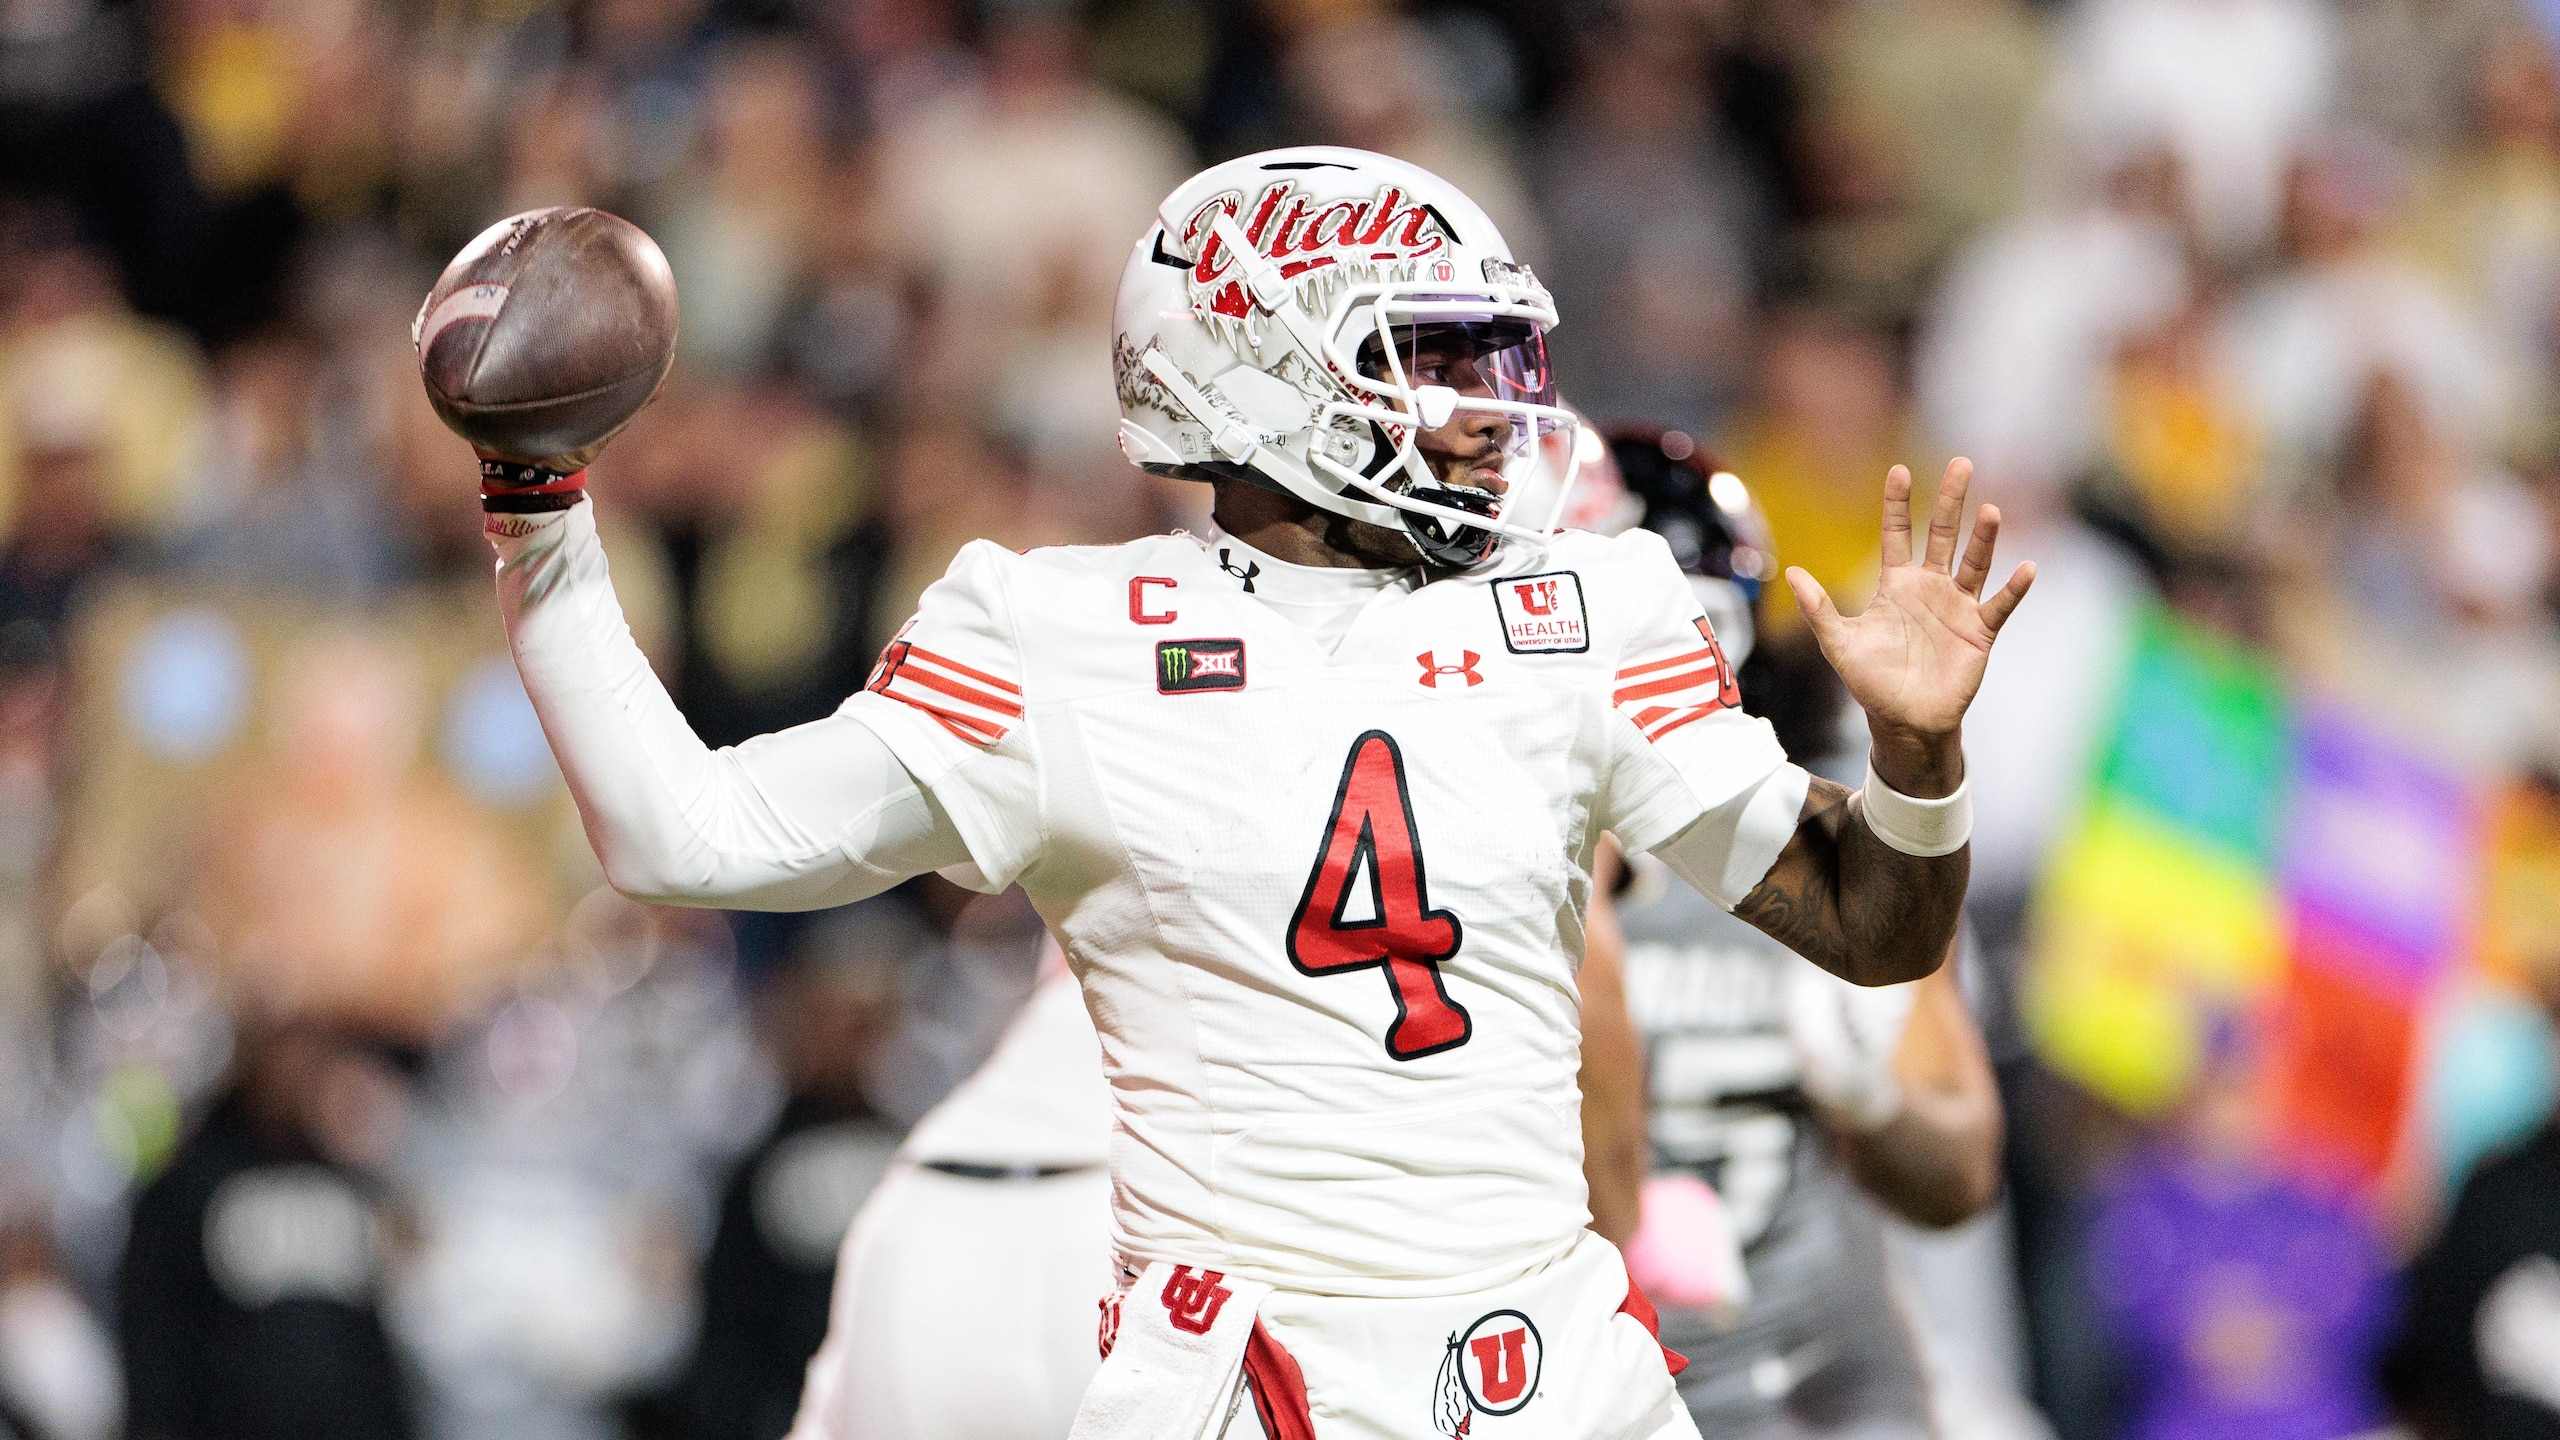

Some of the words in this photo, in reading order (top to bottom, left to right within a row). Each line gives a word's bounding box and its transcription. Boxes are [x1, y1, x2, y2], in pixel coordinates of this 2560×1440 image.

[1182, 181, 1447, 284] Utah
[1129, 576, 1178, 625] C
[1511, 620, 1580, 637] HEALTH
[1513, 638, 1552, 646] UNIVERSITY
[1193, 652, 1237, 675] XII
[1286, 729, 1472, 1061] 4
[1470, 1327, 1526, 1404] U
